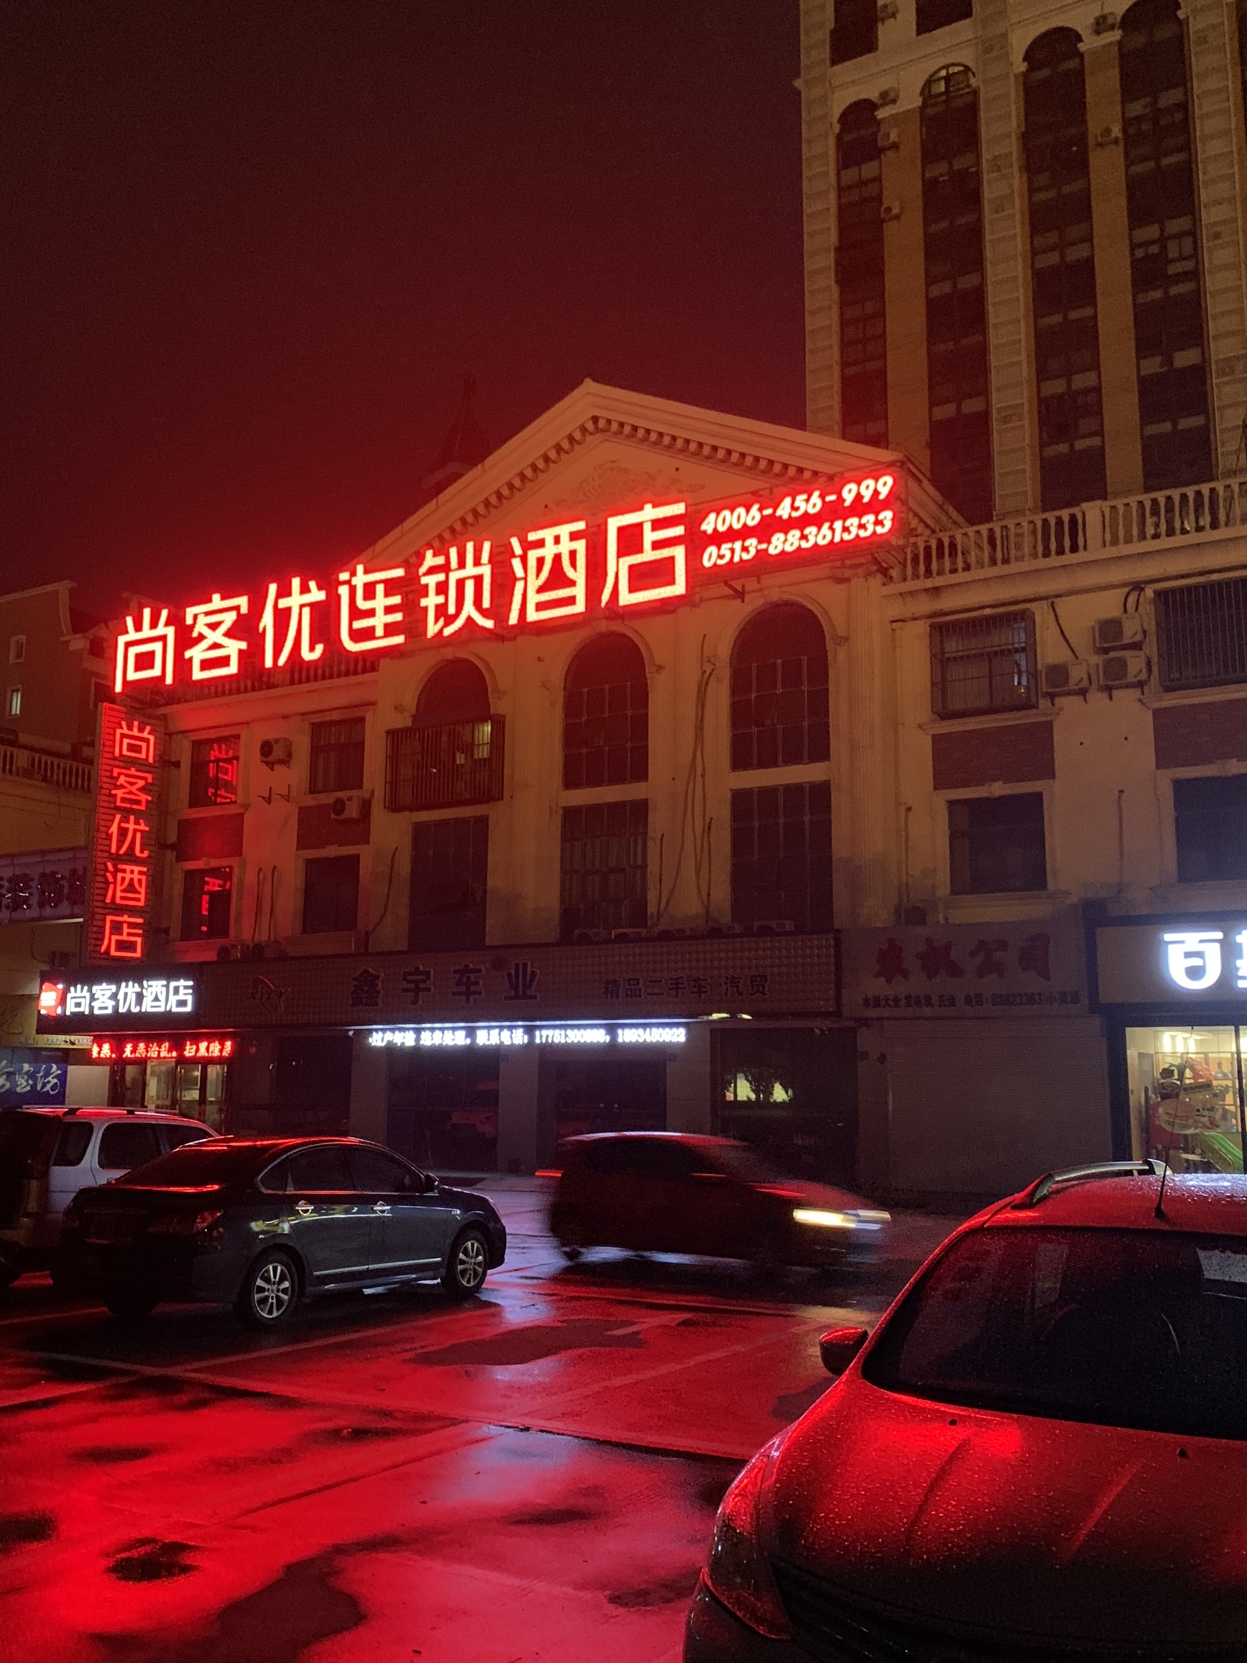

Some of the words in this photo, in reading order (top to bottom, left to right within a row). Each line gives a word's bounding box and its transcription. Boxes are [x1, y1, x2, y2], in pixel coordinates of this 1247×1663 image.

[700, 475, 895, 535] 4006-456-999
[701, 509, 895, 569] 0513-88361333
[113, 500, 688, 694] 尚客优连锁酒店
[100, 719, 156, 959] 尚客优酒店
[350, 960, 541, 1007] 鑫宇车业
[603, 976, 709, 1000] 精品二手车
[723, 974, 768, 998] 汽贸
[1163, 929, 1247, 991] 百
[65, 979, 195, 1017] 尚客优酒店
